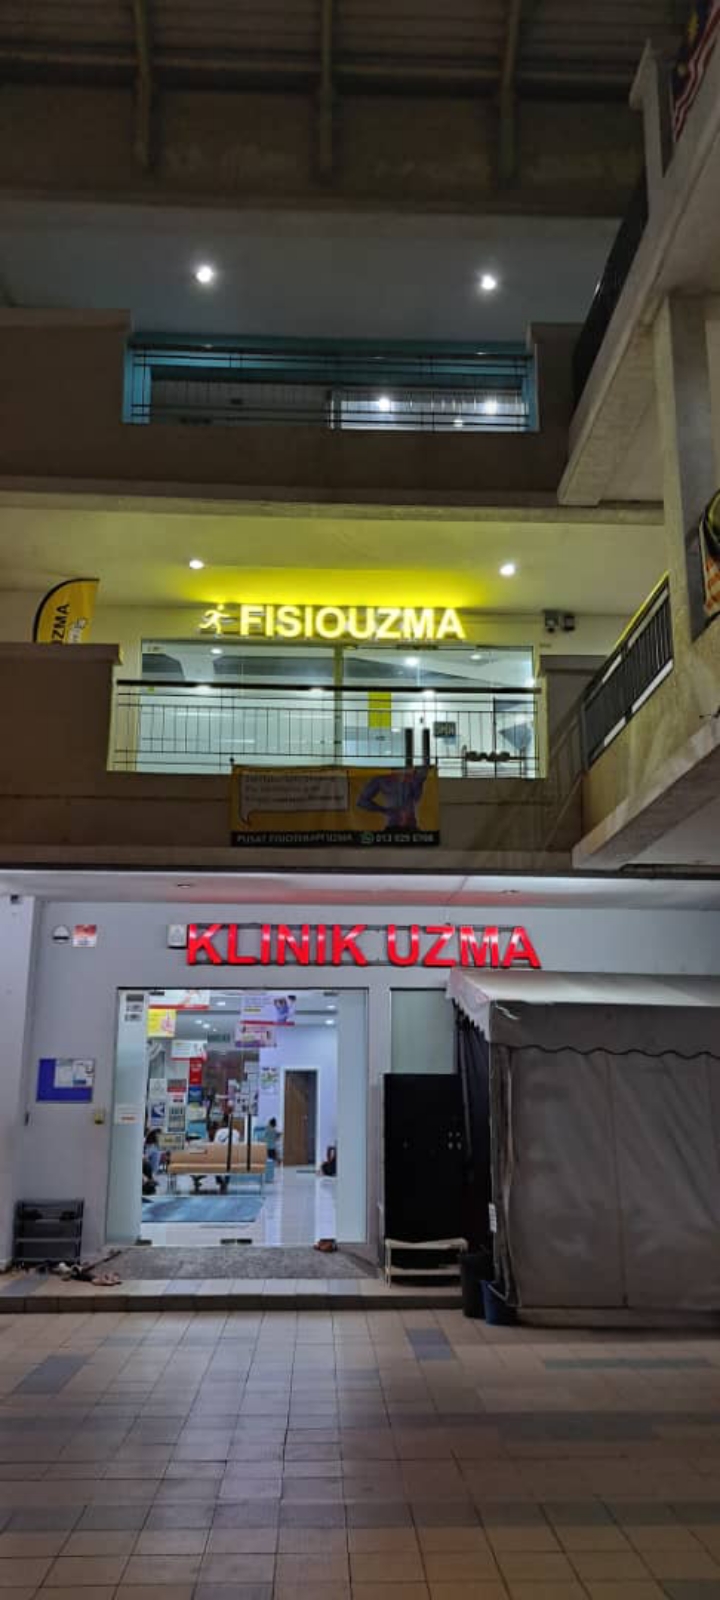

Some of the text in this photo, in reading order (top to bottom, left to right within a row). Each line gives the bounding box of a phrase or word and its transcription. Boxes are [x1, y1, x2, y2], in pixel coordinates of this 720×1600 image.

[52, 603, 70, 644] ZMA
[240, 604, 466, 640] FISIOUZMA
[187, 923, 541, 968] KLINIK UZMA
